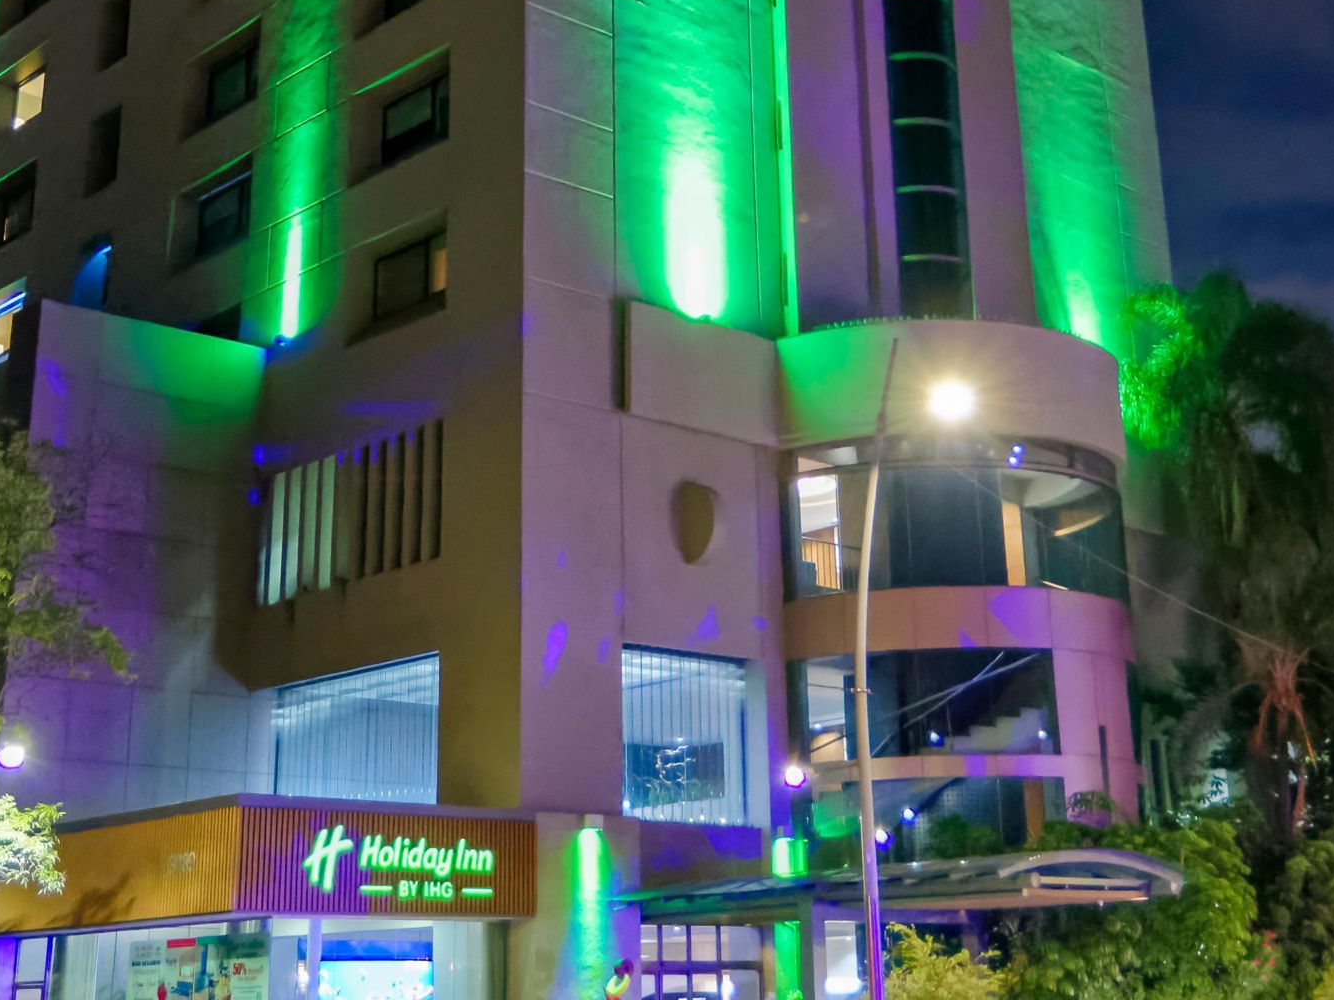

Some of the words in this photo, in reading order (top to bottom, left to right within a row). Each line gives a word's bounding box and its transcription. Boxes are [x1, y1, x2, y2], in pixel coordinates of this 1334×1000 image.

[360, 834, 454, 878] Holiday
[455, 837, 493, 872] Inn
[398, 880, 418, 898] BY
[424, 880, 454, 899] IHG
